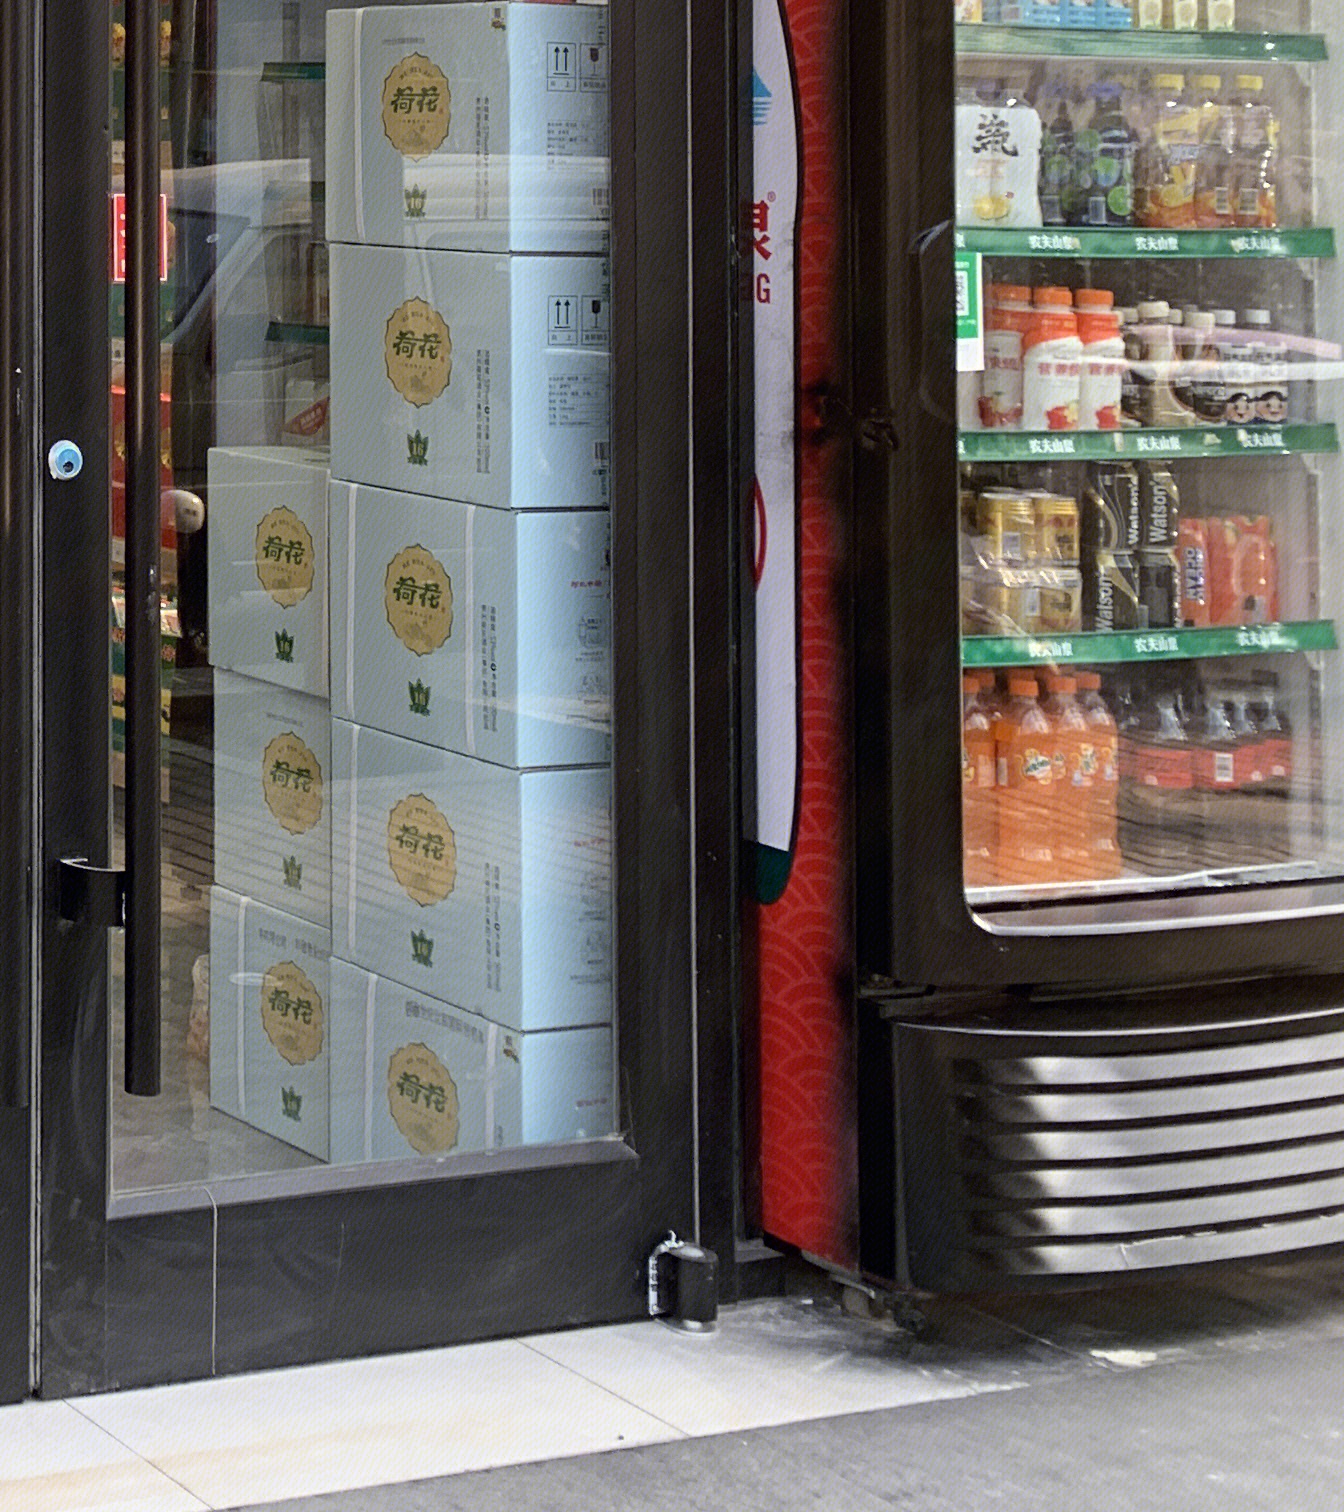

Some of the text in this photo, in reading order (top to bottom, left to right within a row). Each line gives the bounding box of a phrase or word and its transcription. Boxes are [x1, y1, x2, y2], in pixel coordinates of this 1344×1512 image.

[391, 85, 440, 114] 荷花
[392, 329, 442, 360] 荷花
[262, 535, 306, 566] 荷花
[393, 576, 443, 610] 荷花
[269, 758, 314, 793] 荷花
[395, 823, 446, 863] 荷花
[268, 988, 314, 1024] 荷花
[396, 1071, 448, 1114] 荷花
